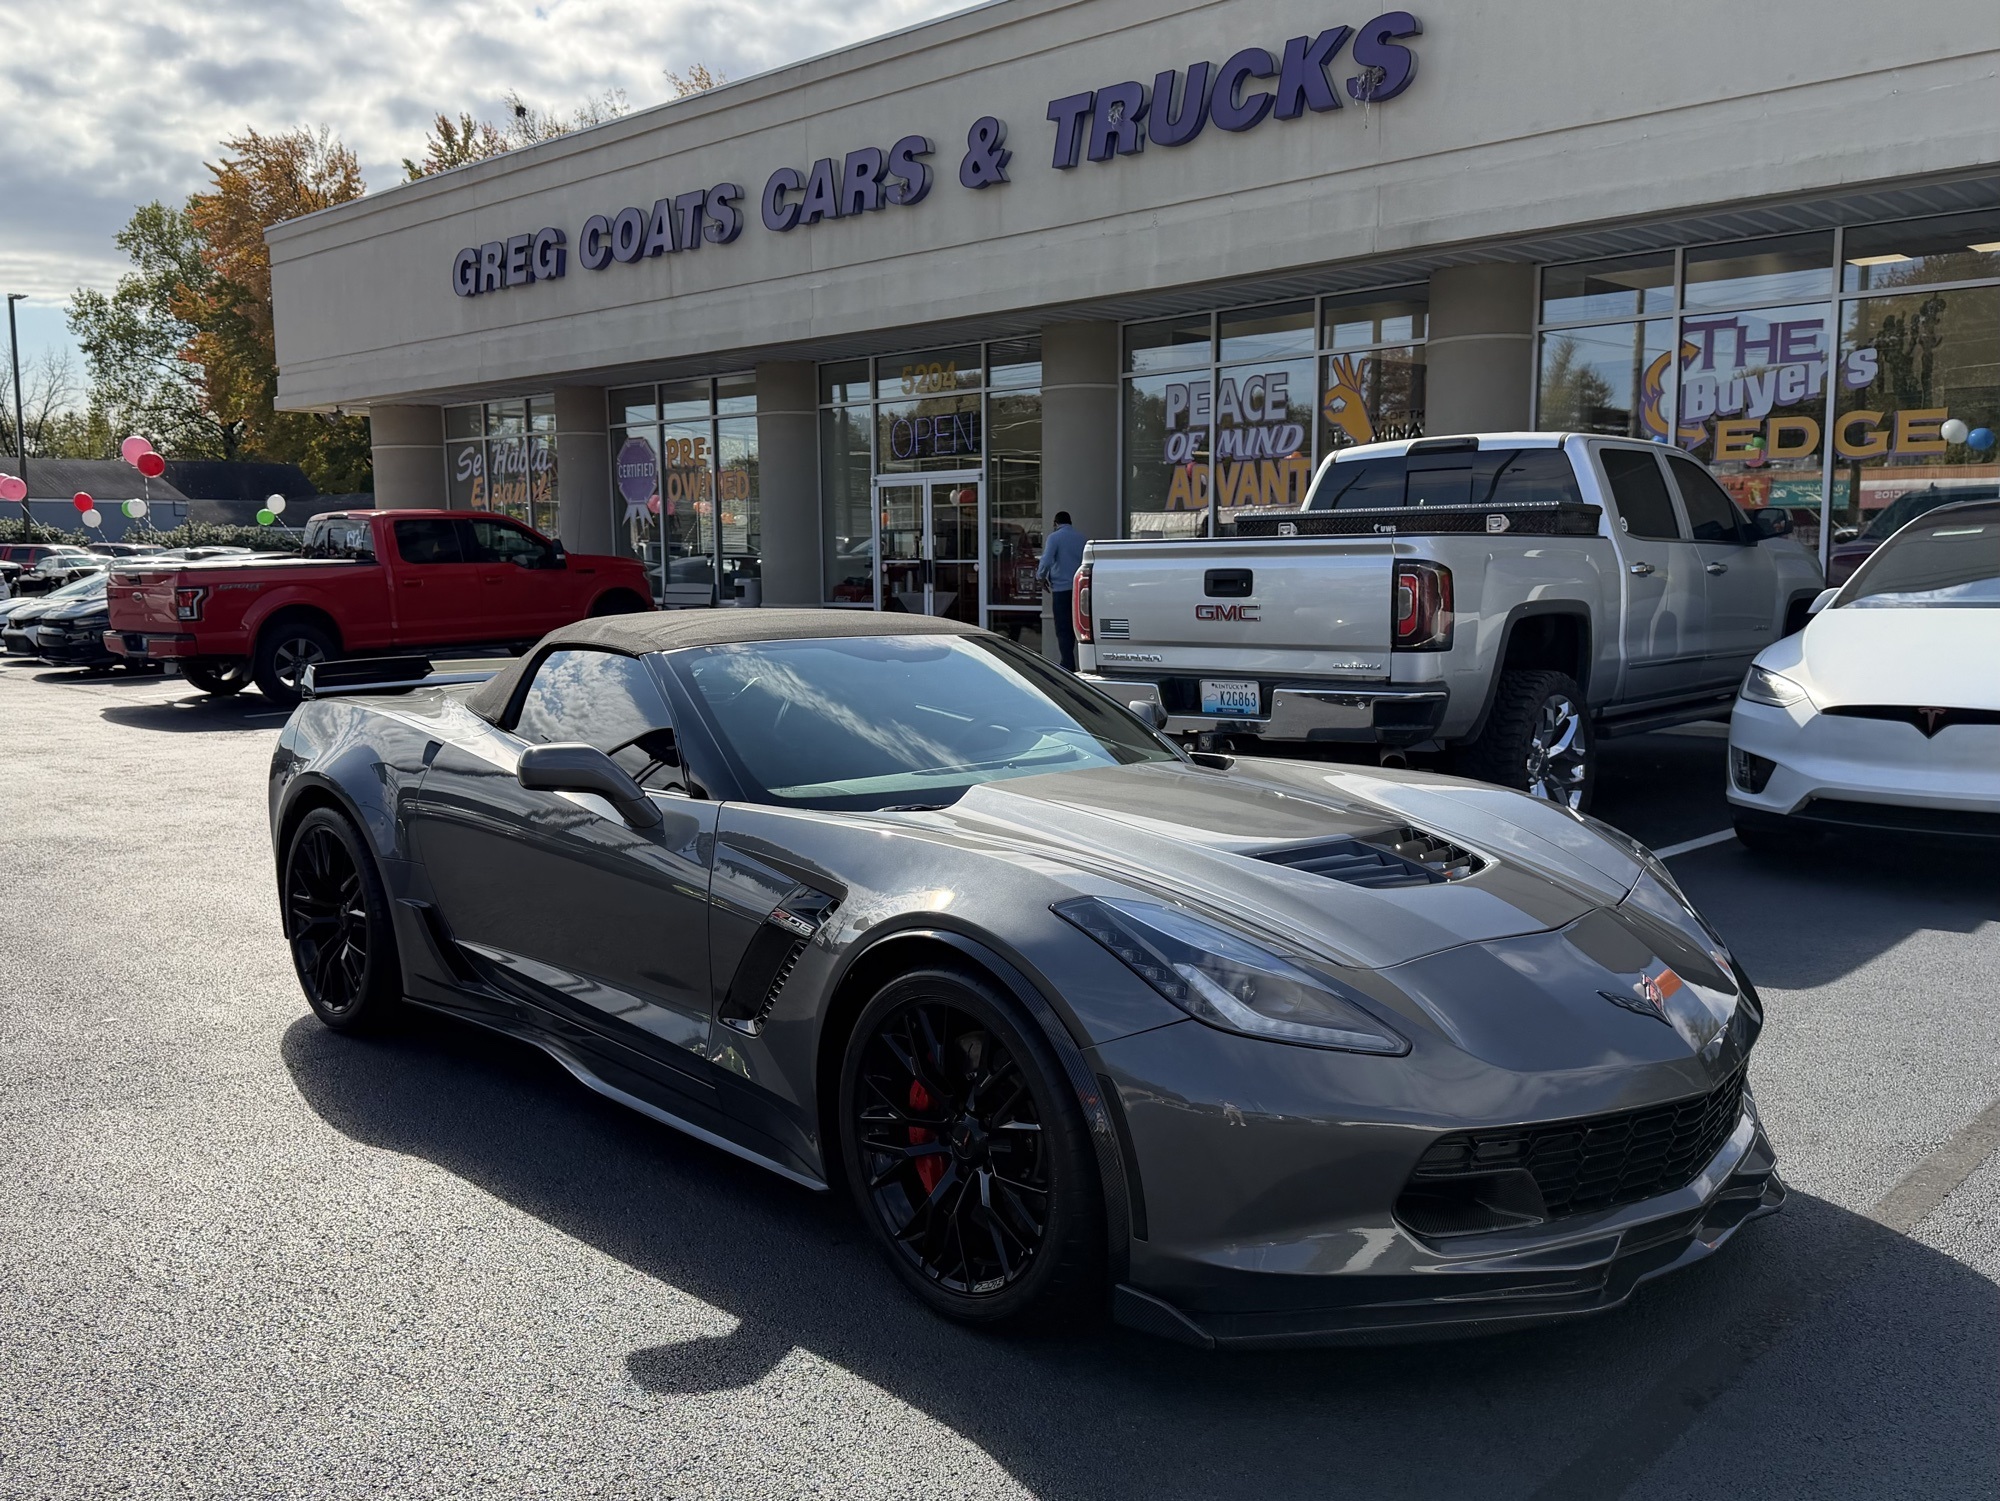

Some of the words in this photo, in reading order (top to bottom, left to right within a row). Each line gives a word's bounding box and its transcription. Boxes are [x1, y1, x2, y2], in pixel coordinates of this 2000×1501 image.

[453, 227, 567, 297] GREG
[580, 183, 744, 270] COATS
[761, 135, 935, 231] CARS
[959, 115, 1013, 190] &
[1046, 10, 1423, 169] TRUCKS
[1682, 316, 1826, 370] THE
[901, 361, 957, 395] 5204
[1681, 347, 1880, 424] Buyer's
[1165, 371, 1289, 430] PEACE
[1409, 409, 1425, 419] TH
[892, 412, 973, 458] OPEN
[1164, 431, 1206, 464] OF
[1216, 423, 1305, 462] MIND
[1714, 406, 1949, 461] EDGE
[457, 446, 482, 481] Se
[492, 440, 552, 475] Habla
[618, 462, 655, 478] CERTIFIED
[666, 437, 712, 468] PRE-
[667, 470, 749, 501] OWNED
[1165, 457, 1312, 510] ADVANT
[1380, 525, 1397, 533] UWS
[1195, 604, 1261, 622] GMC
[1102, 652, 1162, 662] SIERRA
[1220, 690, 1257, 707] K2G863
